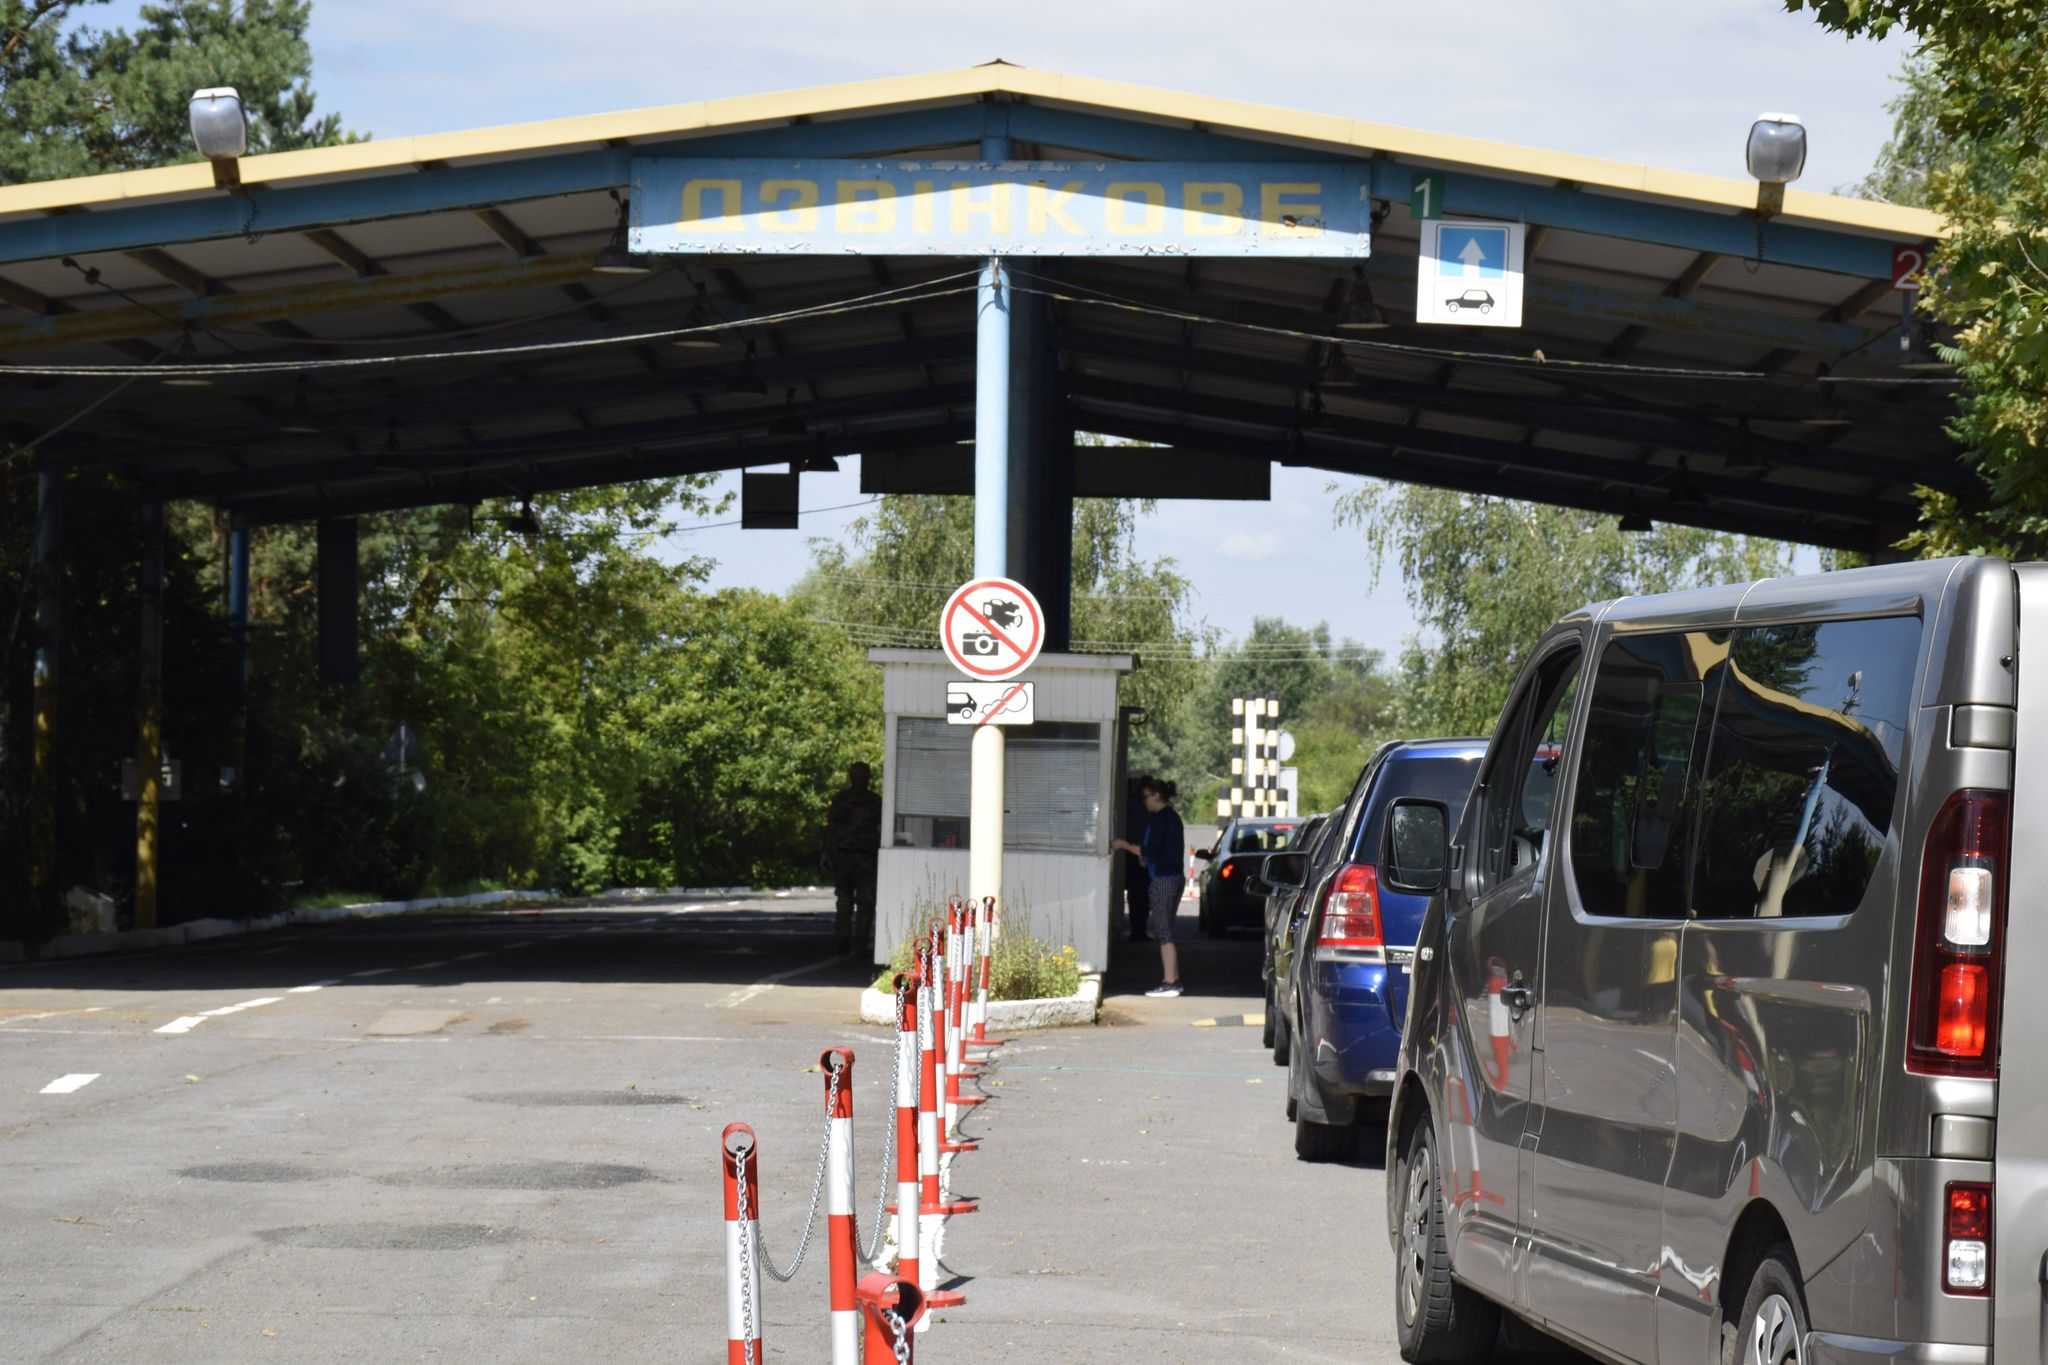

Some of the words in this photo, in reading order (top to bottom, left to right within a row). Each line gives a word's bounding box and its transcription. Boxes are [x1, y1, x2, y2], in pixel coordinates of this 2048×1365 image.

[675, 178, 1322, 238] ДЗВІНКОВЕ
[1415, 178, 1431, 217] 1
[1894, 250, 1922, 289] 2
